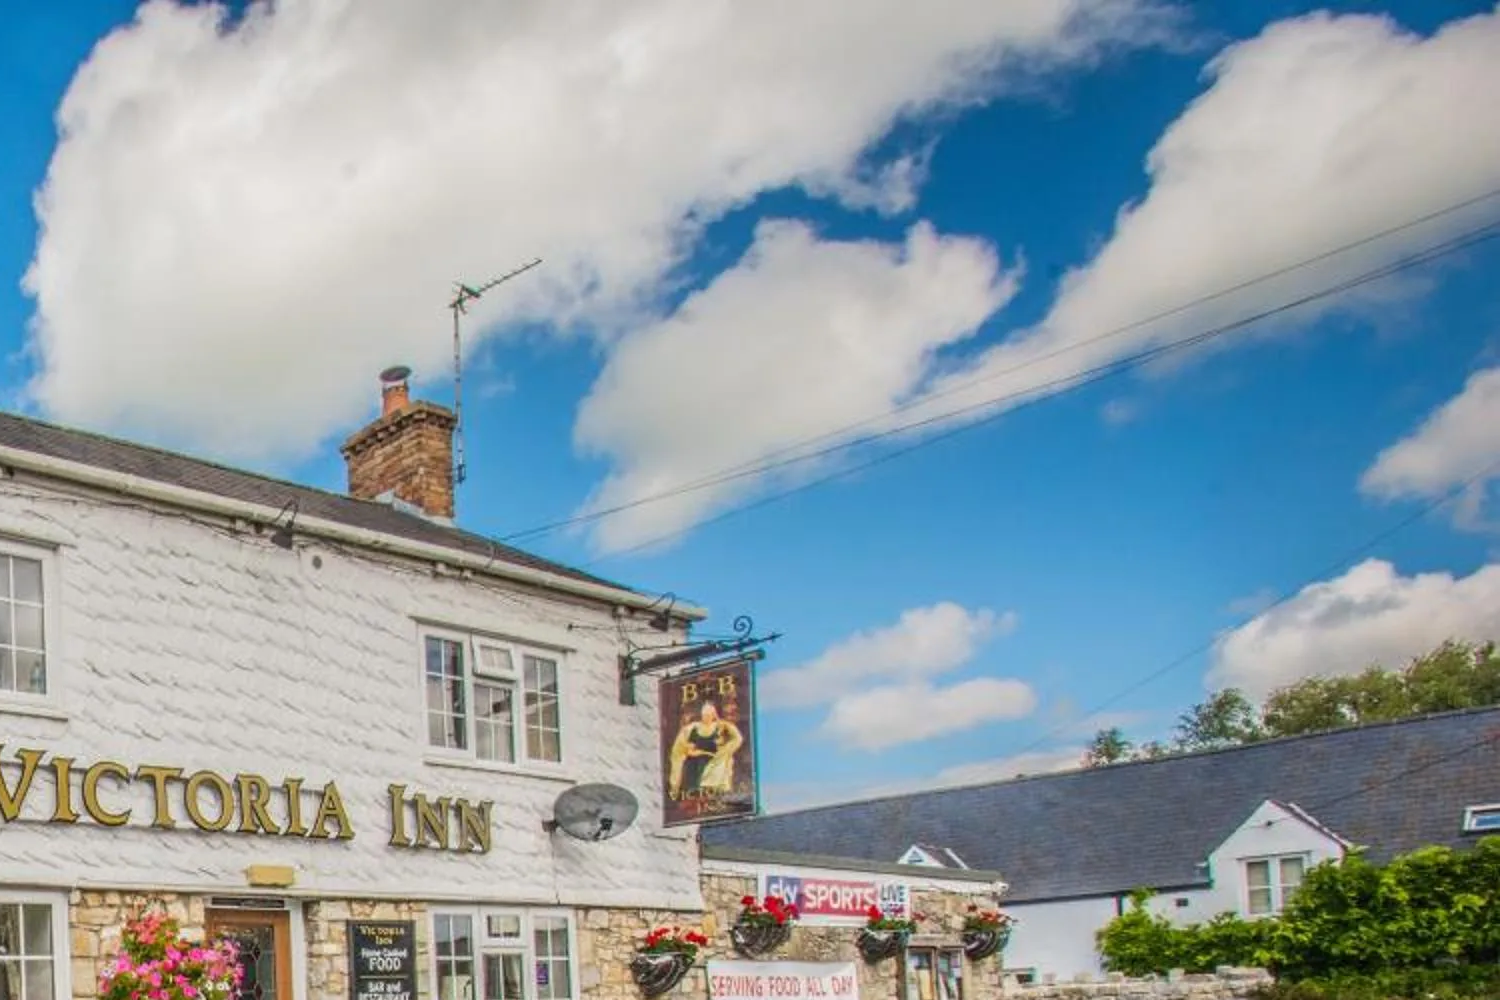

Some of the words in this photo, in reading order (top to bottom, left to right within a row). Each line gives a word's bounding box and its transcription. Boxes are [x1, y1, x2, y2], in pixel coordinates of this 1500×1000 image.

[681, 683, 698, 703] B
[717, 675, 737, 697] B
[388, 783, 494, 853] INN
[803, 883, 877, 911] SPORTS
[882, 884, 905, 903] LIVE
[369, 957, 401, 971] FOOD
[711, 976, 764, 997] SERVING
[768, 976, 801, 996] FOOD
[806, 975, 827, 996] ALL
[831, 975, 854, 995] DAY
